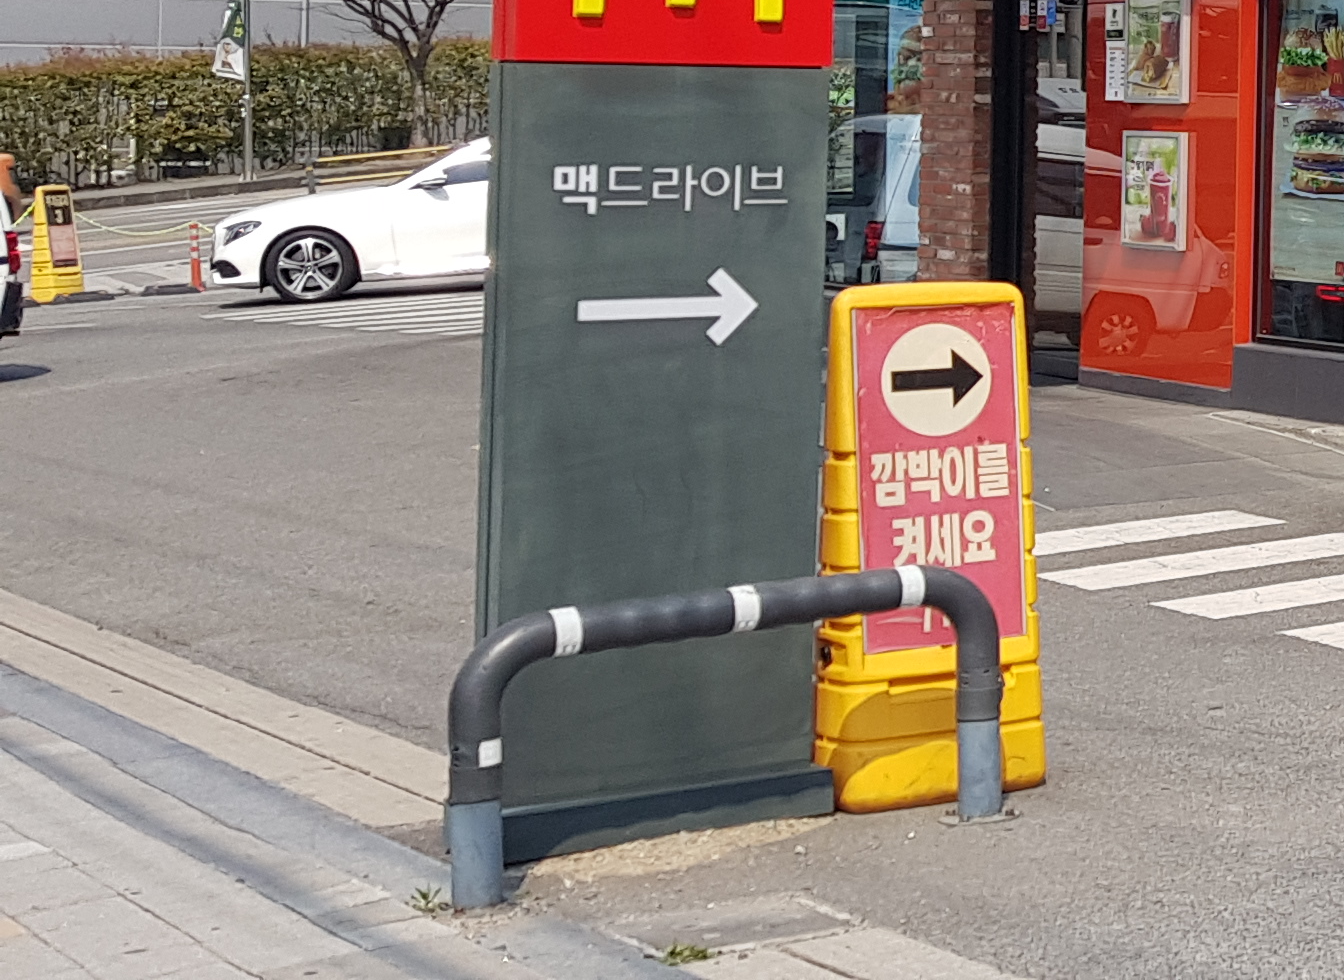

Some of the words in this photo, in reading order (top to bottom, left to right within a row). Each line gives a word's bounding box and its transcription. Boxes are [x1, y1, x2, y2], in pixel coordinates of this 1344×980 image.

[553, 164, 789, 215] 맥드라이브
[870, 443, 1010, 507] 깜박이를
[892, 510, 997, 567] 켜세요
